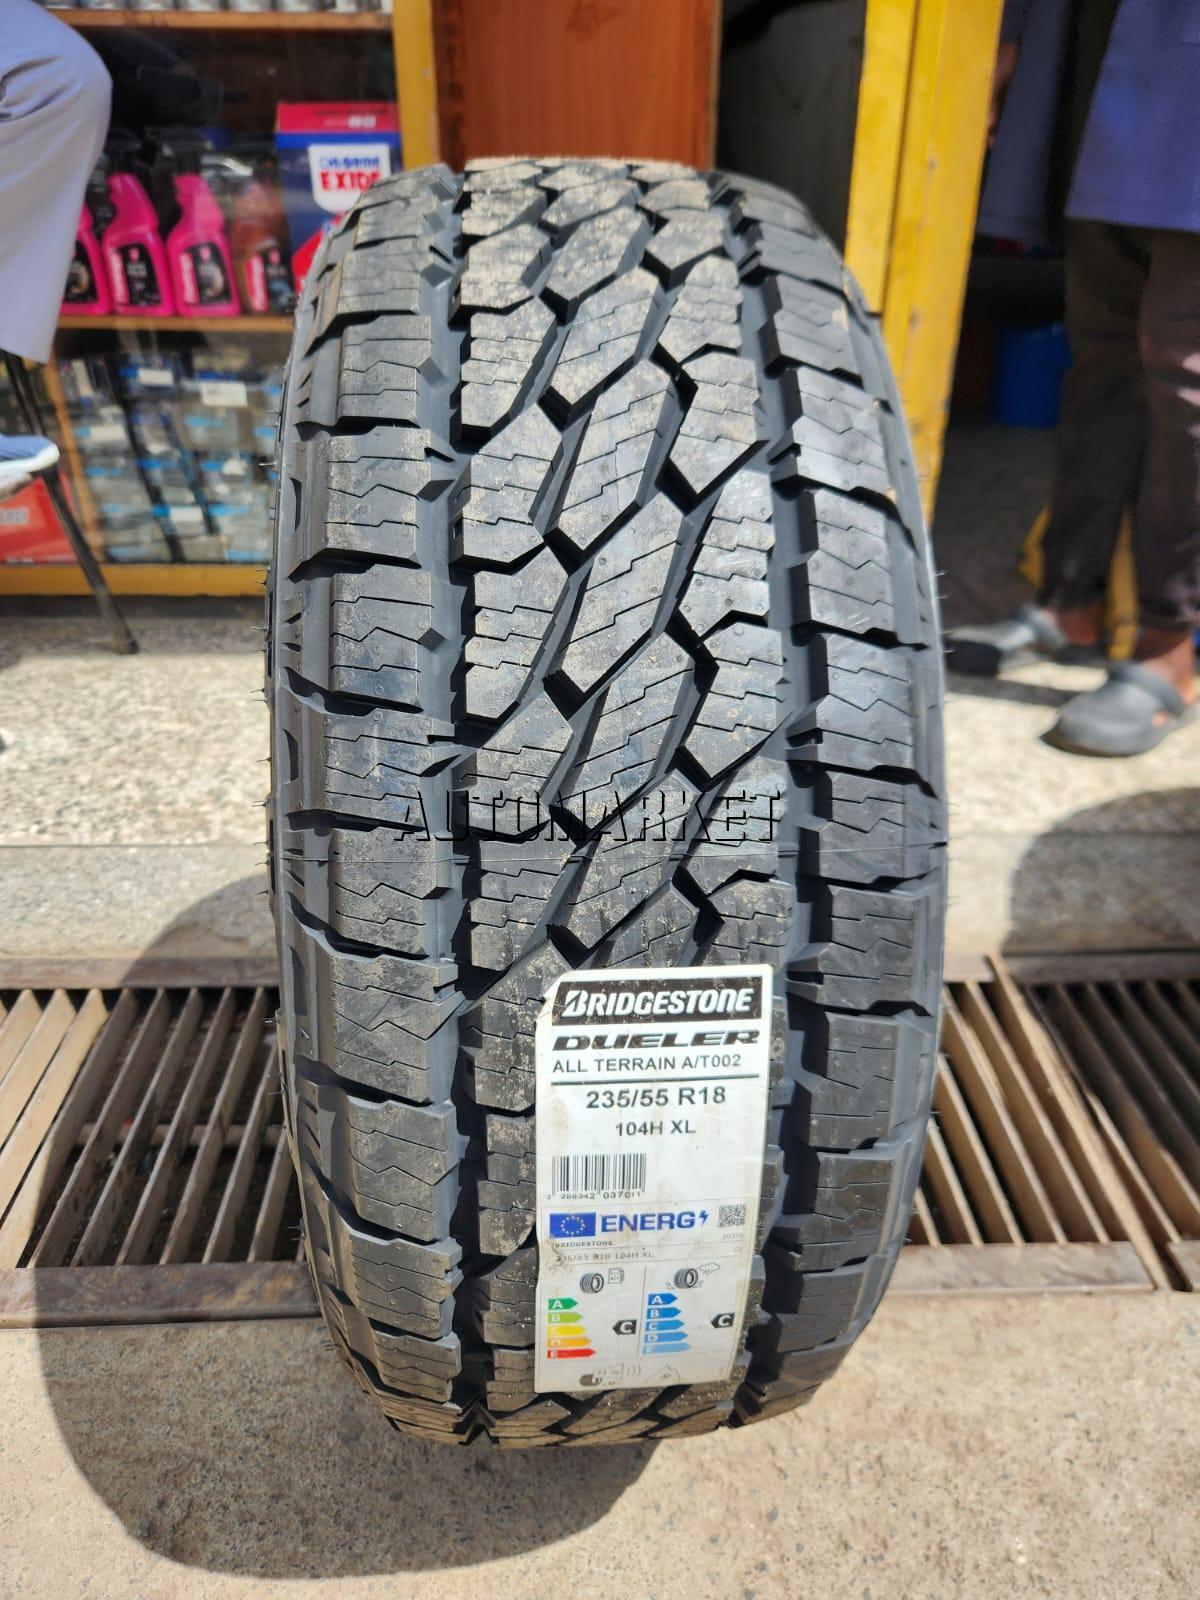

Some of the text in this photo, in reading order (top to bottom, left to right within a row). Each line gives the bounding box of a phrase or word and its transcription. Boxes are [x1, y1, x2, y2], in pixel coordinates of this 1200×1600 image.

[561, 988, 754, 1018] BRIDGESTONE
[552, 1029, 760, 1051] DUELER
[552, 1054, 741, 1073] ALL TERRAIN A/T002
[586, 1086, 726, 1109] 235/55 R18
[615, 1119, 696, 1136] 104H XL
[601, 1211, 696, 1233] ENERG
[555, 1240, 613, 1248] BRIDGESTONE
[552, 1301, 563, 1309] A
[652, 1295, 663, 1305] A
[552, 1313, 561, 1322] B
[650, 1310, 660, 1318] B
[649, 1322, 659, 1331] C
[718, 1315, 730, 1328] C
[619, 1322, 633, 1335] C
[648, 1333, 658, 1342] D
